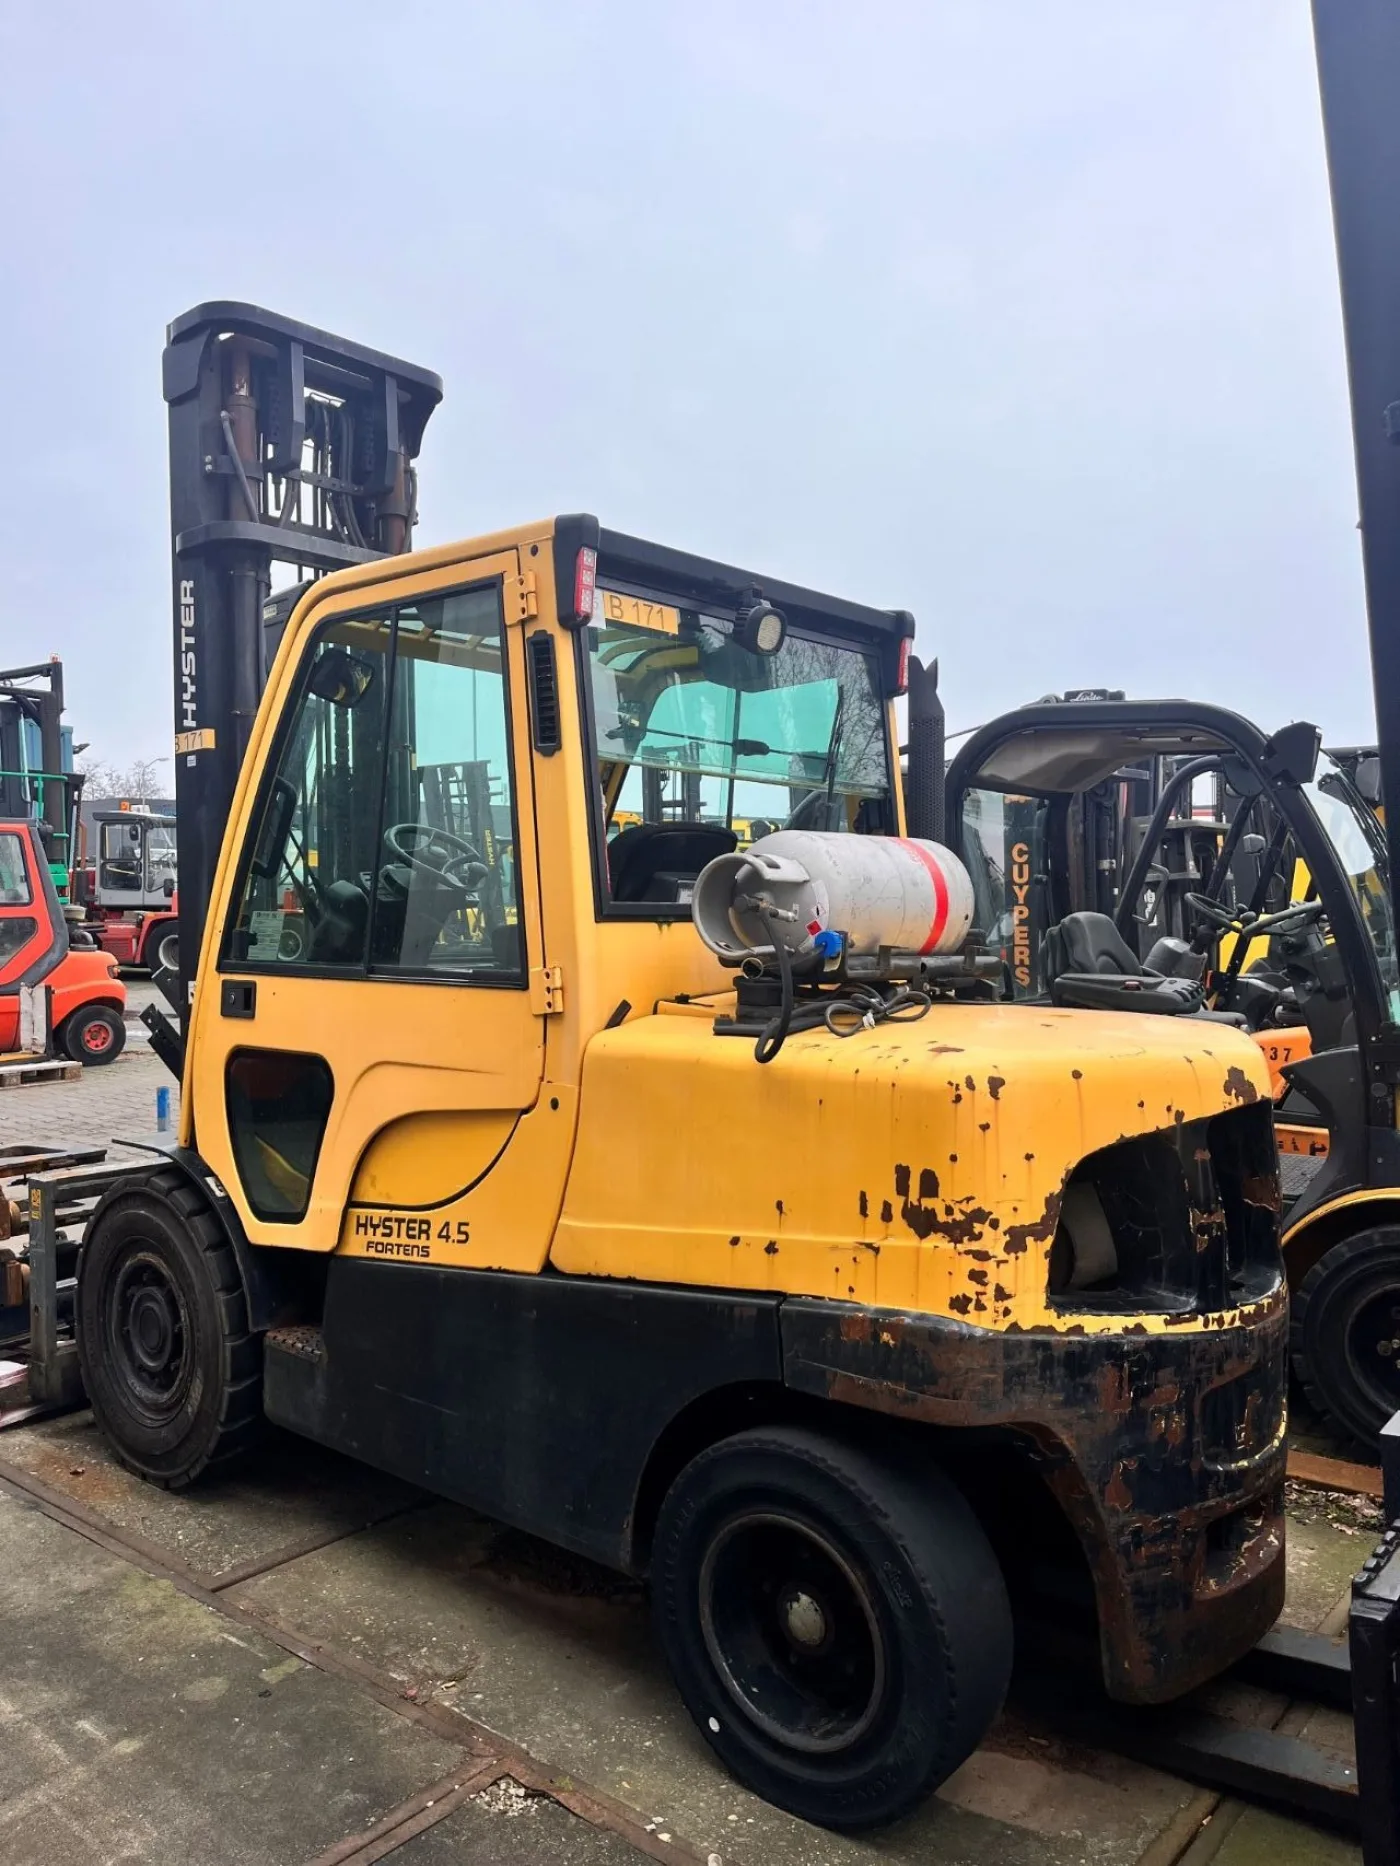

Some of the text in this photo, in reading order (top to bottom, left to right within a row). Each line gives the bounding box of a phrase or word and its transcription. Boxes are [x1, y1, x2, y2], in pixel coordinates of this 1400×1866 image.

[608, 594, 665, 630] B 171
[180, 579, 198, 728] HYSTER
[184, 731, 203, 750] 171
[1011, 842, 1031, 988] CUYPERS
[1260, 1045, 1292, 1062] 37
[355, 1214, 470, 1244] HYSTER 4.5
[366, 1240, 430, 1258] FORTENS
